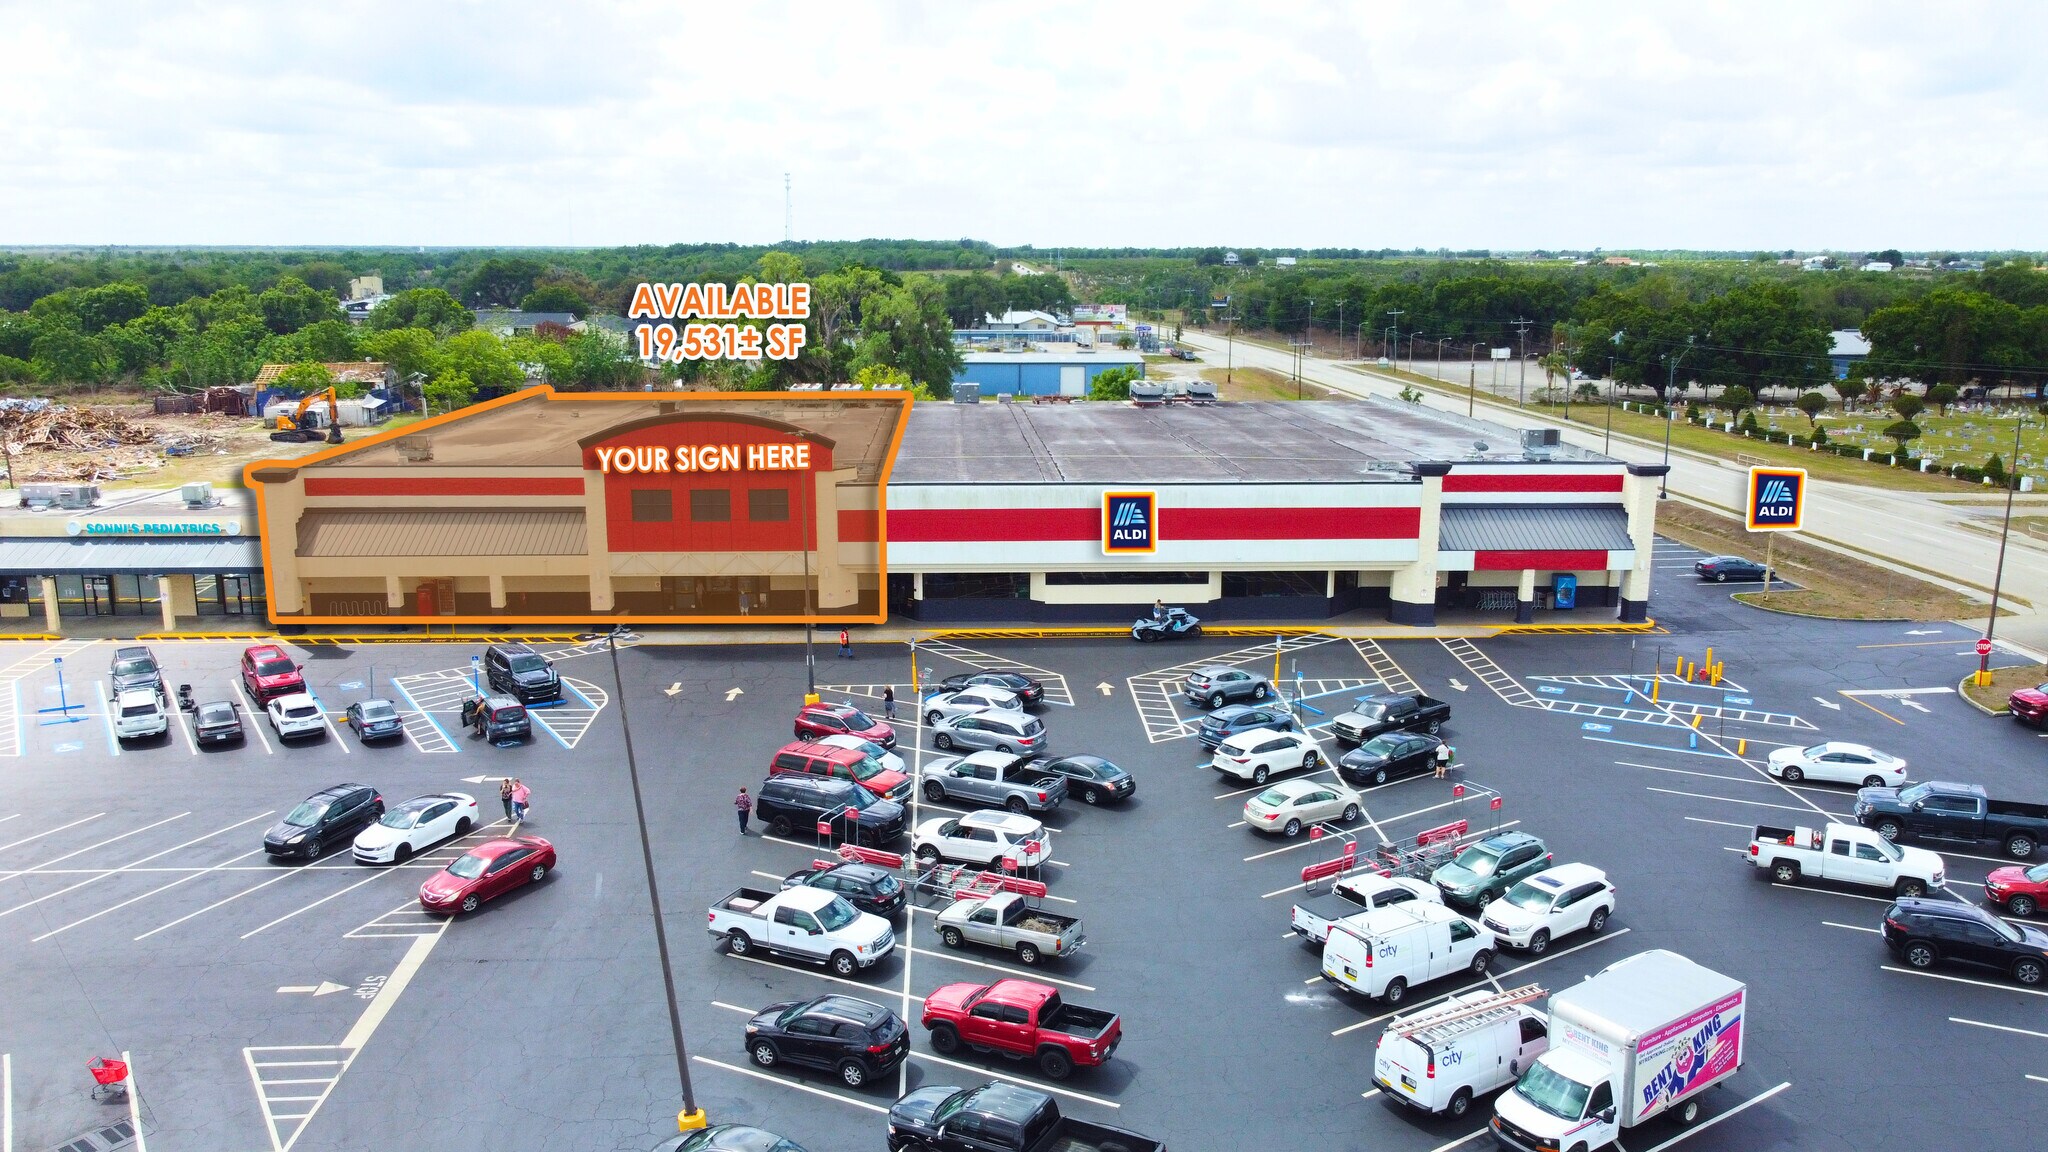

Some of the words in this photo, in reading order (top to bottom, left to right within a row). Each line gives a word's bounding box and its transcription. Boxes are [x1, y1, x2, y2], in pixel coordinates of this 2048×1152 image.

[86, 523, 140, 535] SONNI'S
[143, 523, 221, 535] PEDIATRICS
[1976, 643, 1991, 651] STOP
[1380, 945, 1398, 958] city
[353, 975, 388, 999] STOP
[1572, 1029, 1591, 1044] RENT
[1591, 1038, 1609, 1054] KING
[1442, 1050, 1463, 1067] city
[1642, 1061, 1673, 1105] RENT
[1692, 1013, 1722, 1054] KING
